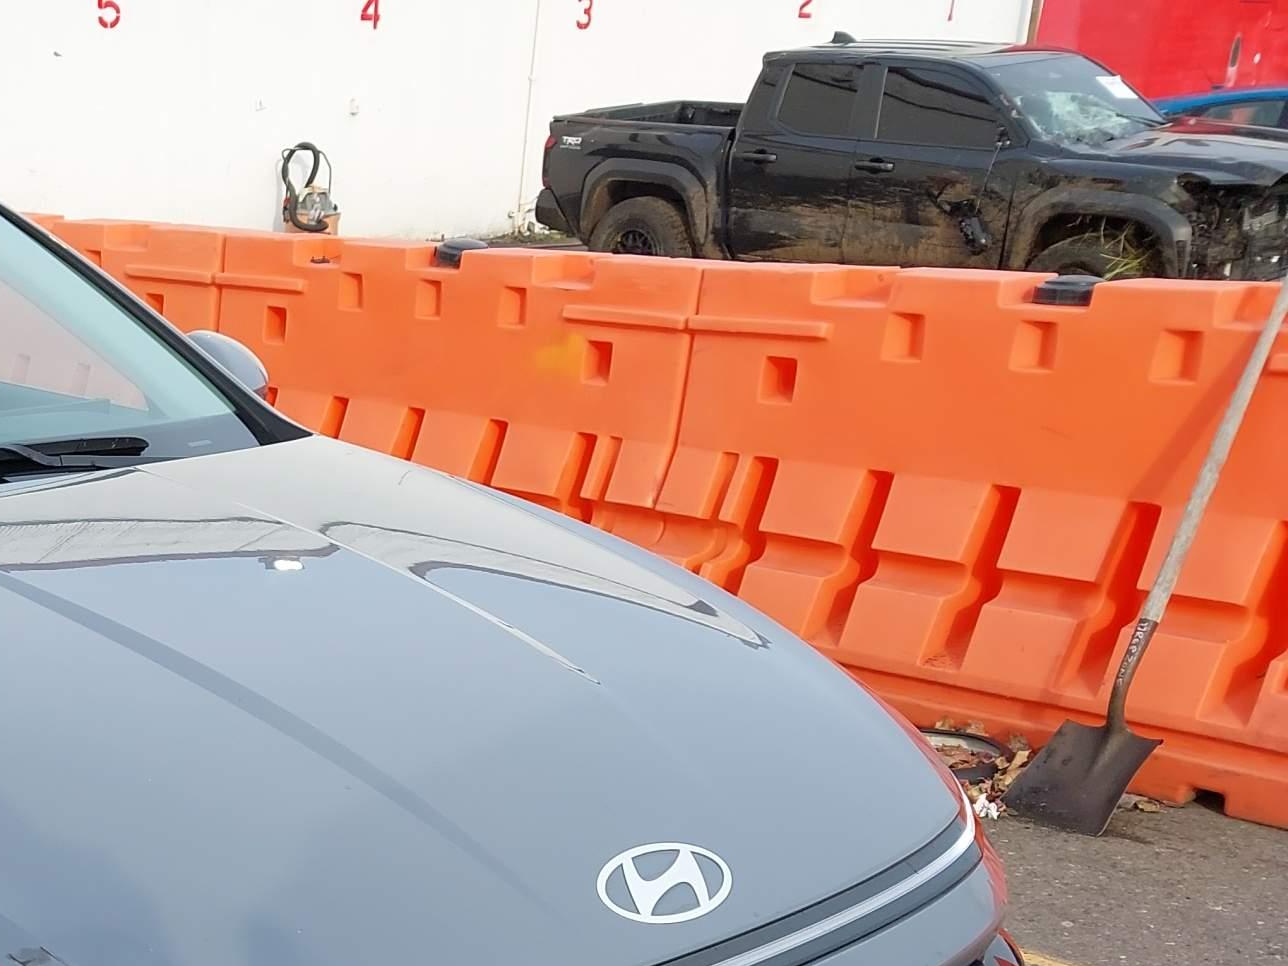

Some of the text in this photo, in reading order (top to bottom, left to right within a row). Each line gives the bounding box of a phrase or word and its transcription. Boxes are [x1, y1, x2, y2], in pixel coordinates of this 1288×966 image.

[96, 0, 121, 29] 5
[360, 0, 381, 30] 4
[576, 0, 594, 30] 3
[562, 135, 582, 145] TRD
